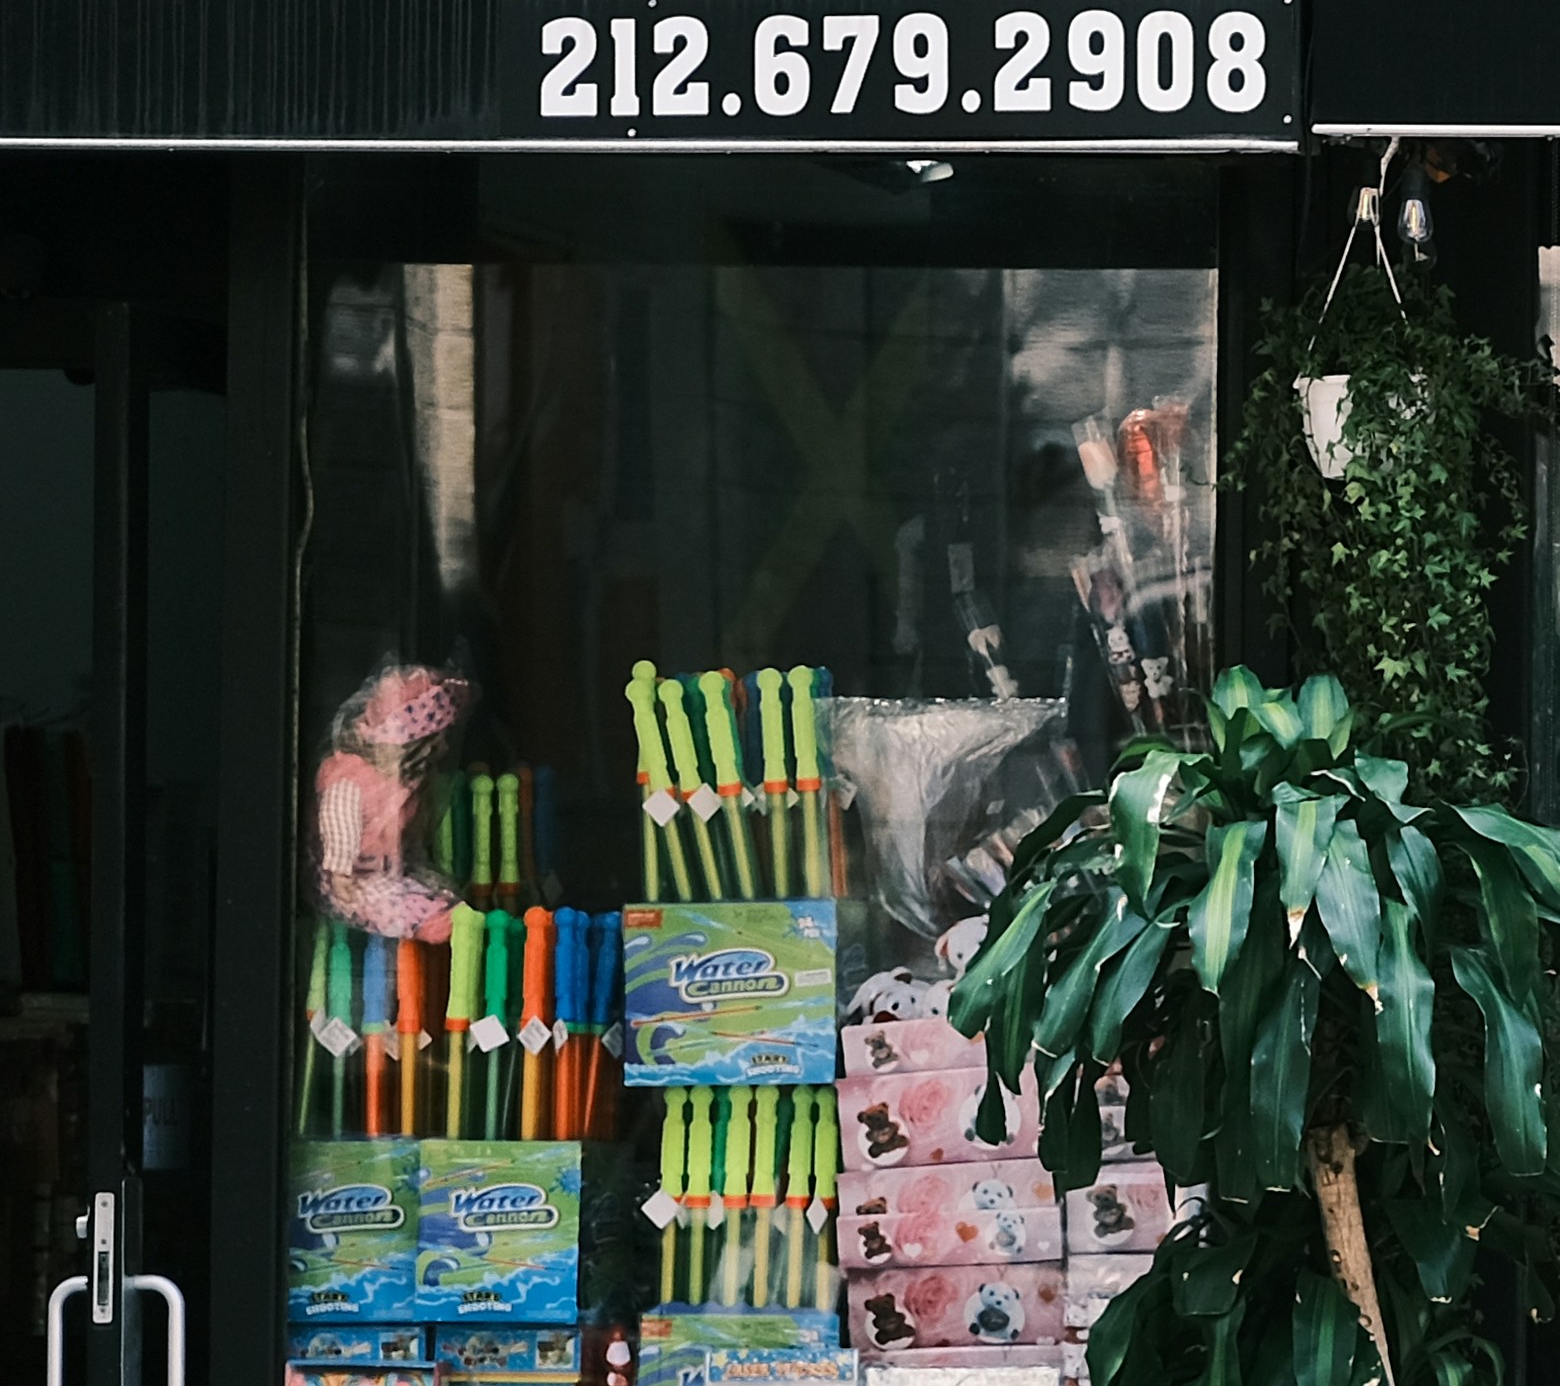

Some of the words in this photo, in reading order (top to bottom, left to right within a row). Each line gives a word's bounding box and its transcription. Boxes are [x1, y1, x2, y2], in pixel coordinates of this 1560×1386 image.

[539, 10, 1268, 119] 212.679.2908
[674, 956, 768, 985] Water
[686, 977, 780, 997] Cannon
[299, 1192, 384, 1215] Water
[453, 1192, 539, 1215] Water
